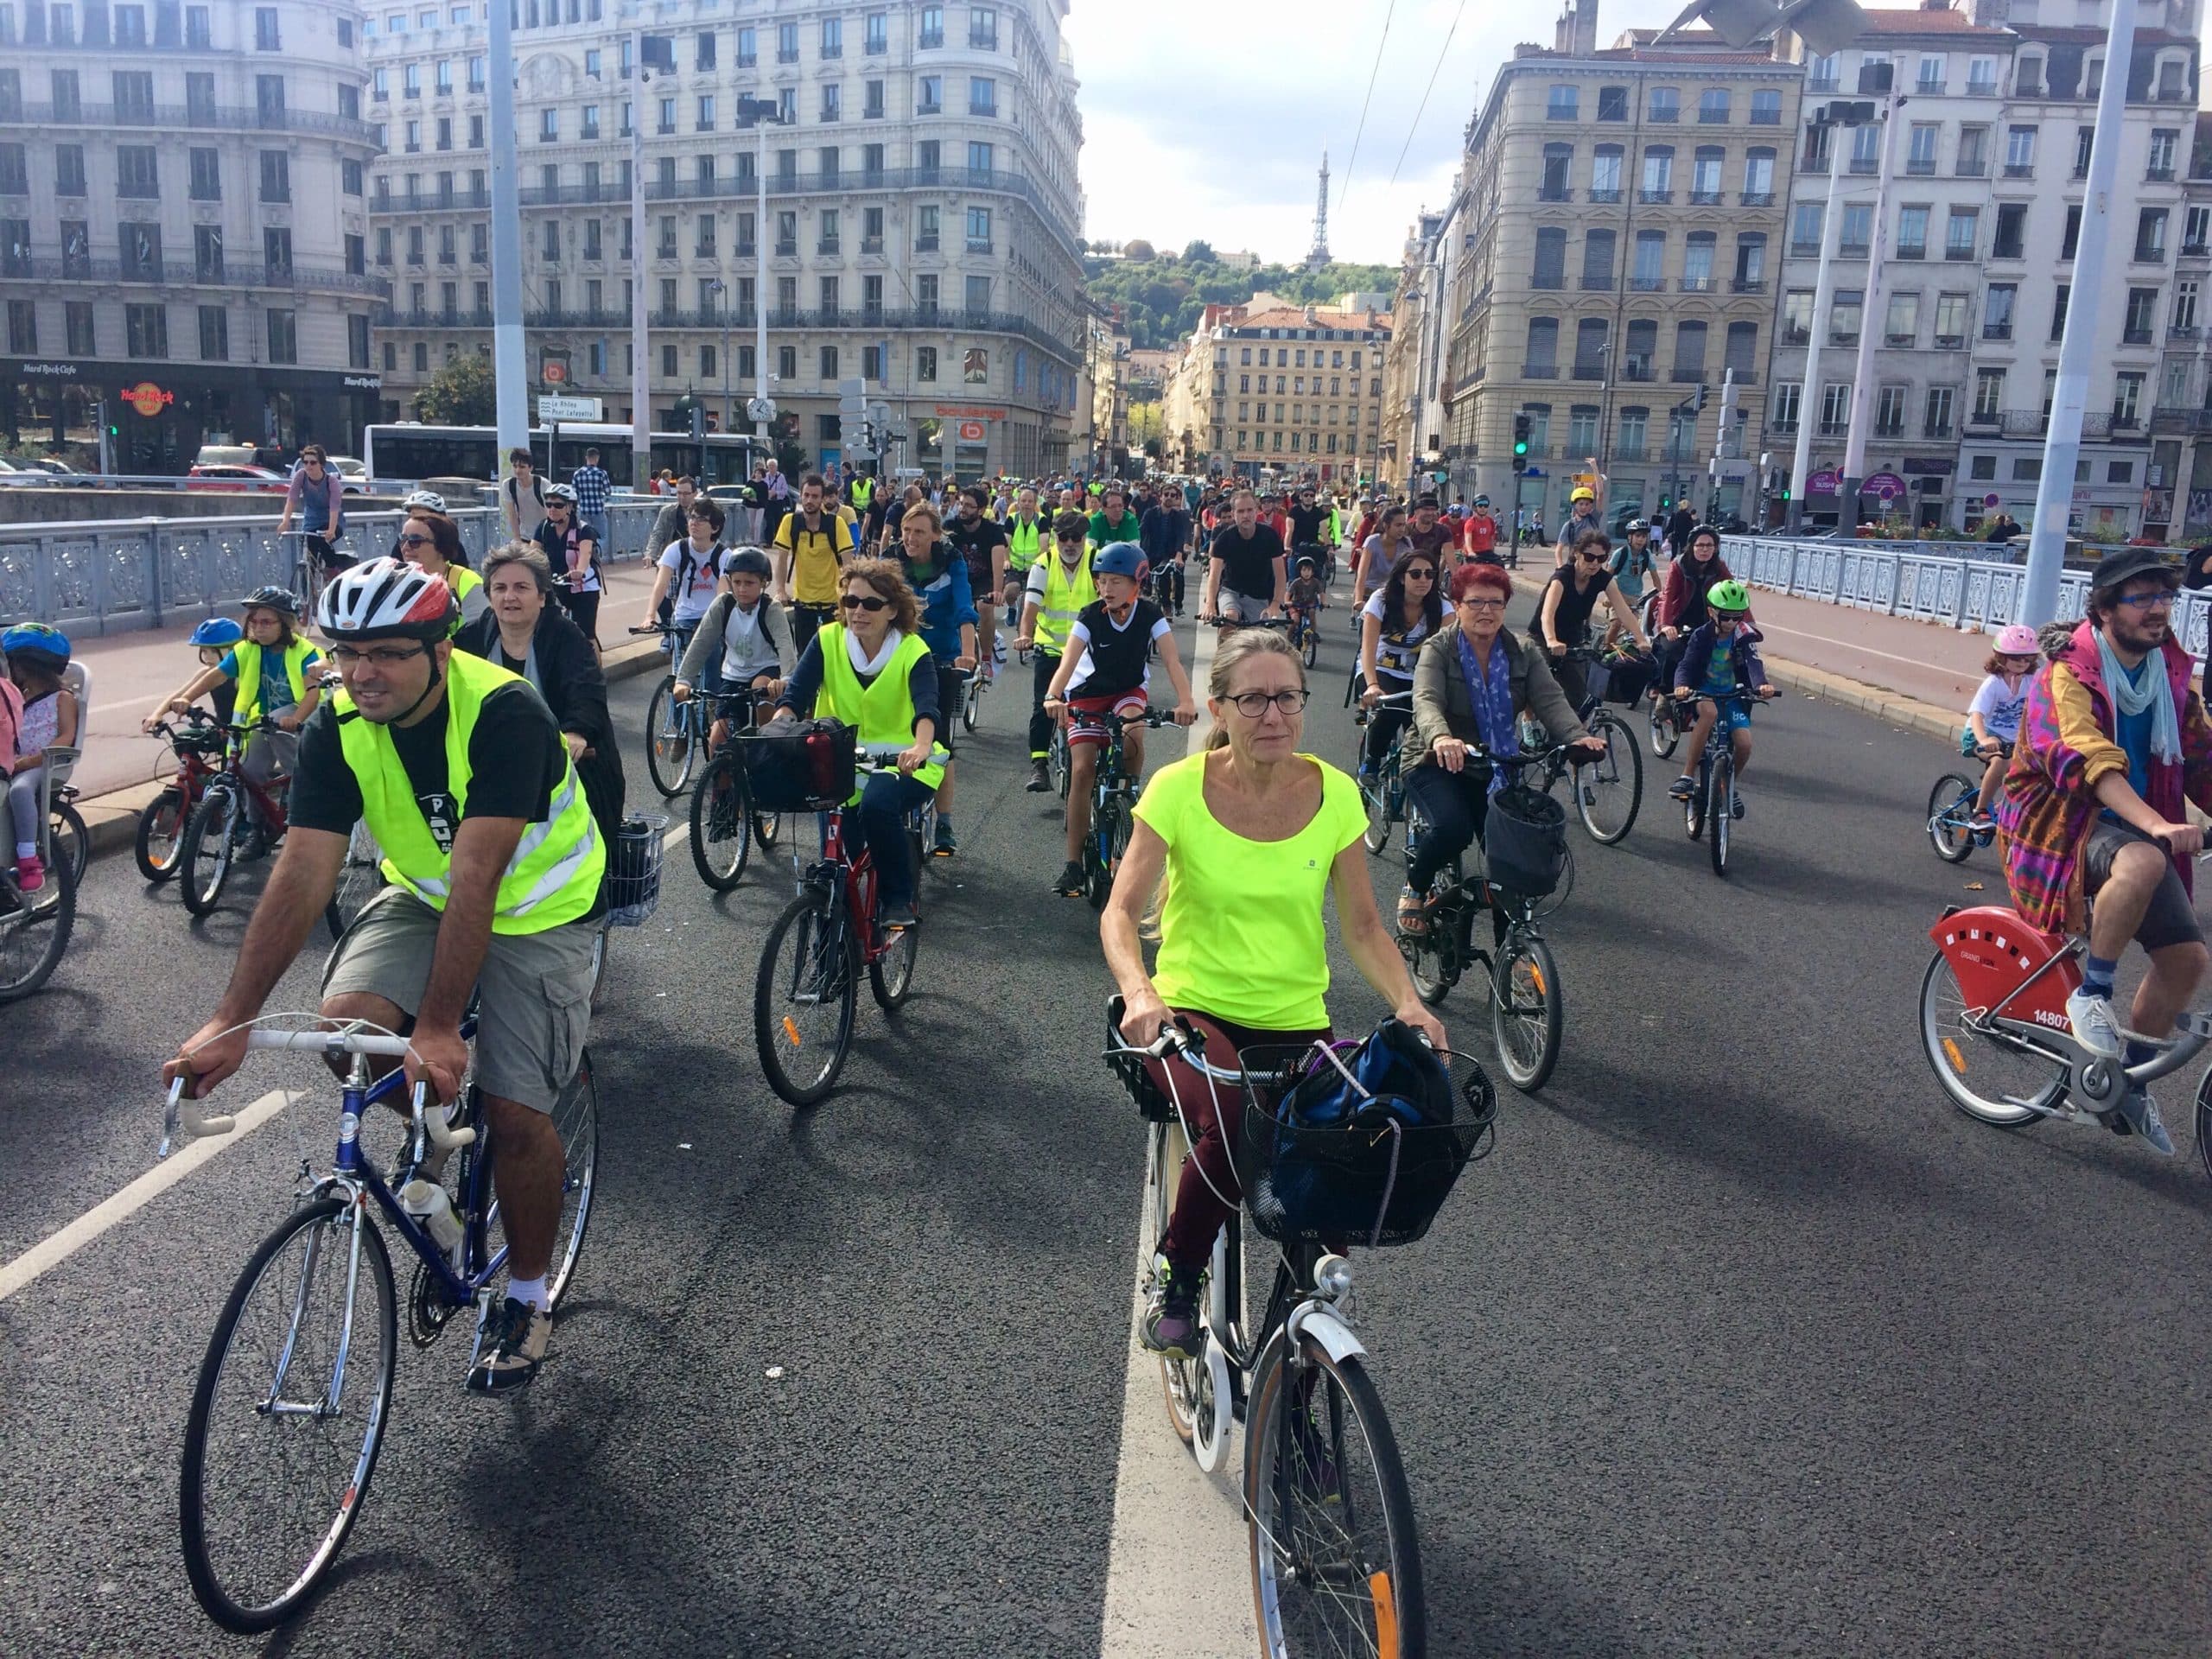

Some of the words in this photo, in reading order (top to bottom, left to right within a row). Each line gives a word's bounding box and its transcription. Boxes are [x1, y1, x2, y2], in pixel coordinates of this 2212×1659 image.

[23, 364, 41, 372] Hard
[42, 364, 60, 374] Rock
[60, 365, 76, 375] Cafe
[121, 389, 146, 401] Hard
[149, 389, 174, 404] Rock
[935, 404, 1006, 422] boulanger
[1961, 950, 1980, 963] GRAND
[2033, 1008, 2070, 1029] 14807
